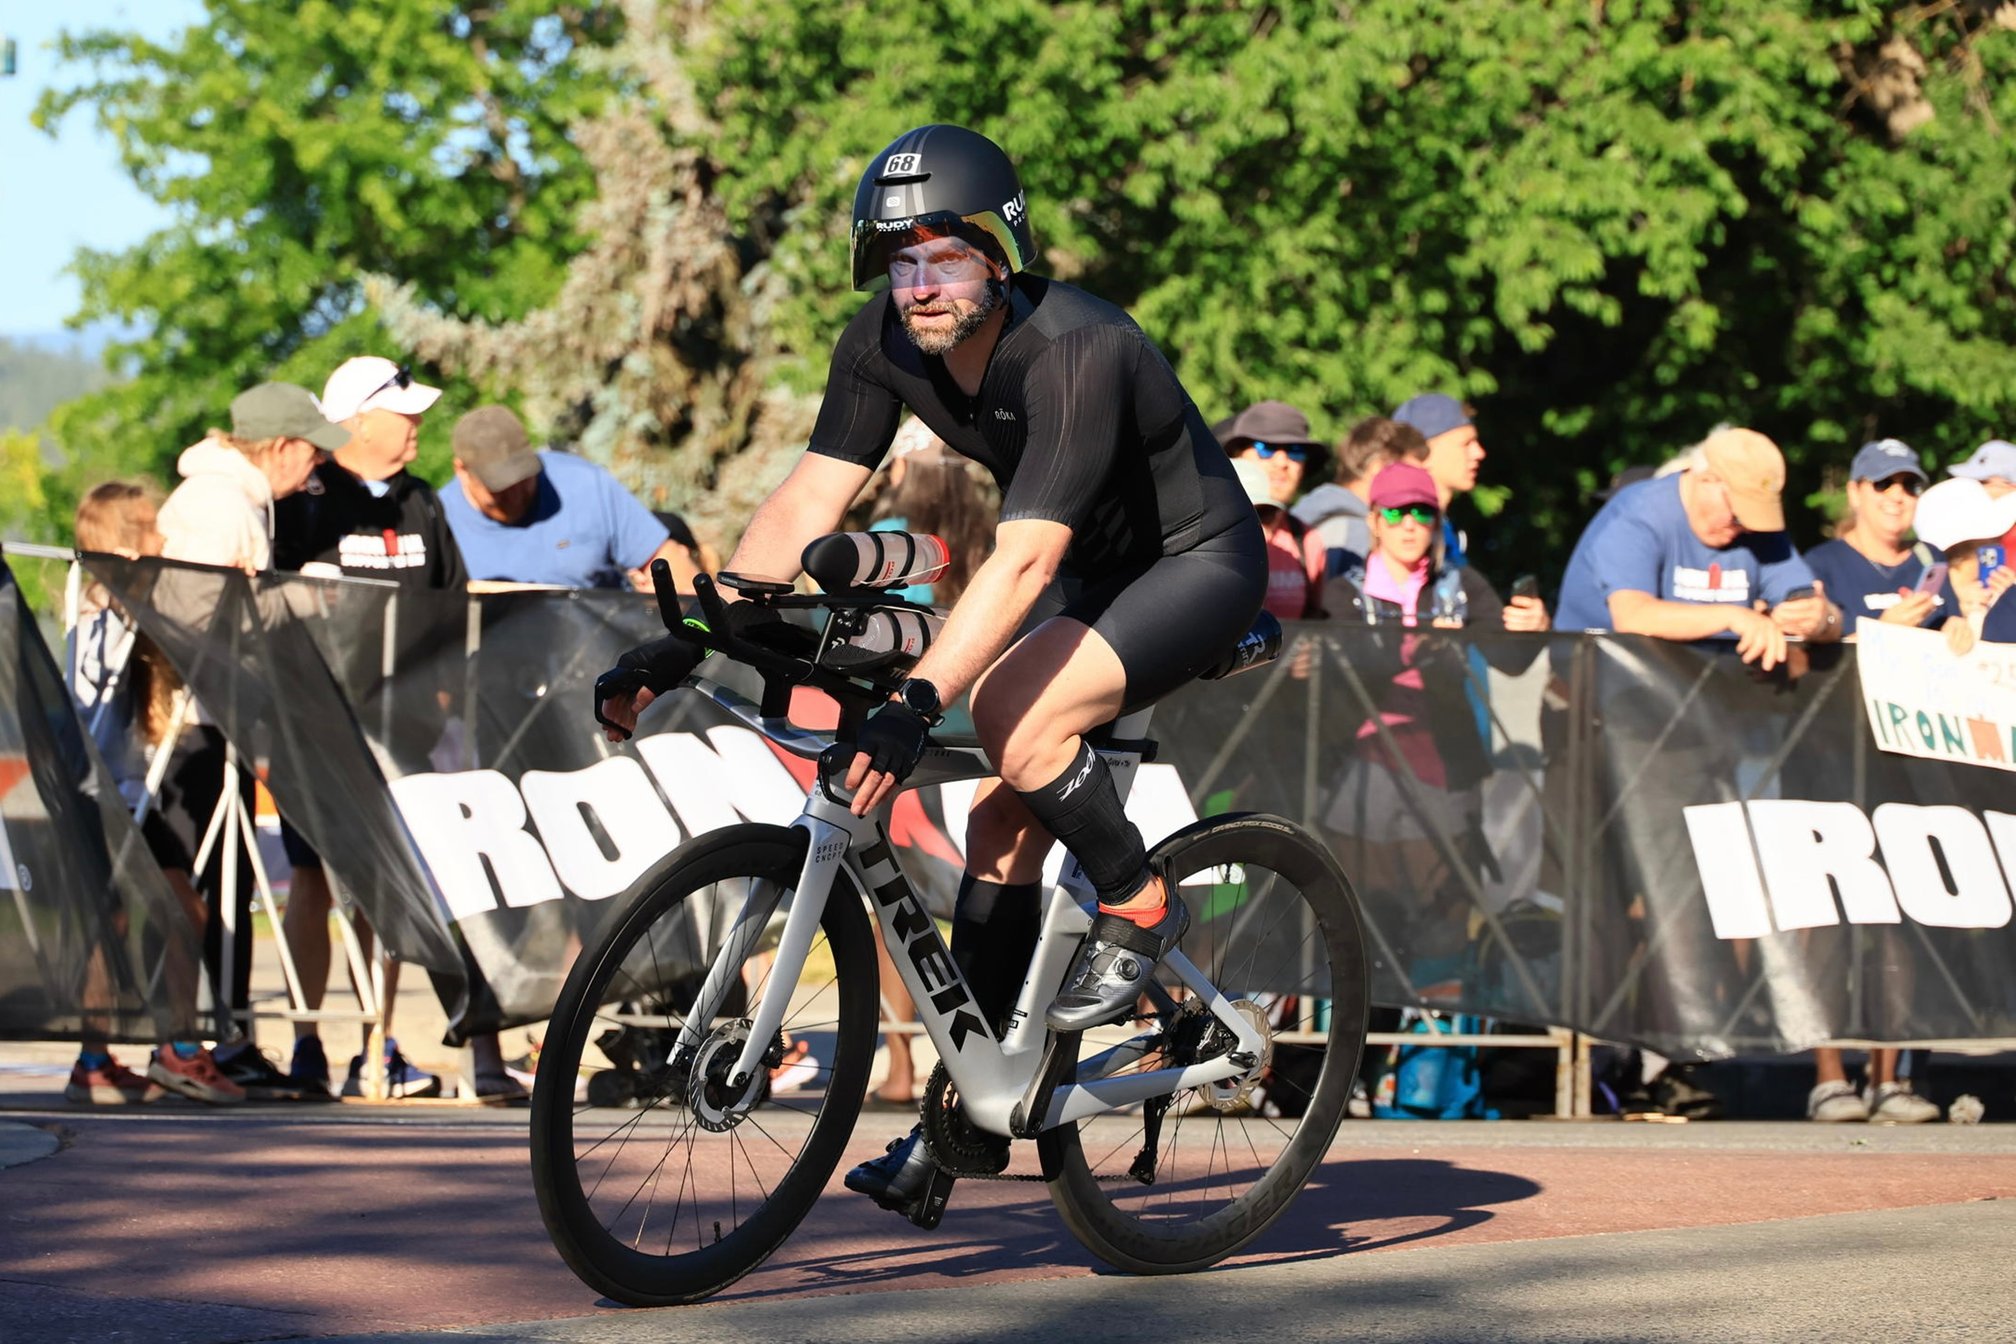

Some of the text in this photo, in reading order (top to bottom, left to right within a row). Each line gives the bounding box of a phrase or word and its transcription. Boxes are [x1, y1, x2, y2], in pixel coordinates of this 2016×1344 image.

[887, 155, 916, 173] 68
[1002, 189, 1026, 221] RU
[876, 219, 914, 230] RUDY
[817, 842, 844, 855] SPEED
[1683, 799, 2016, 939] IRO
[859, 820, 990, 1054] TREK
